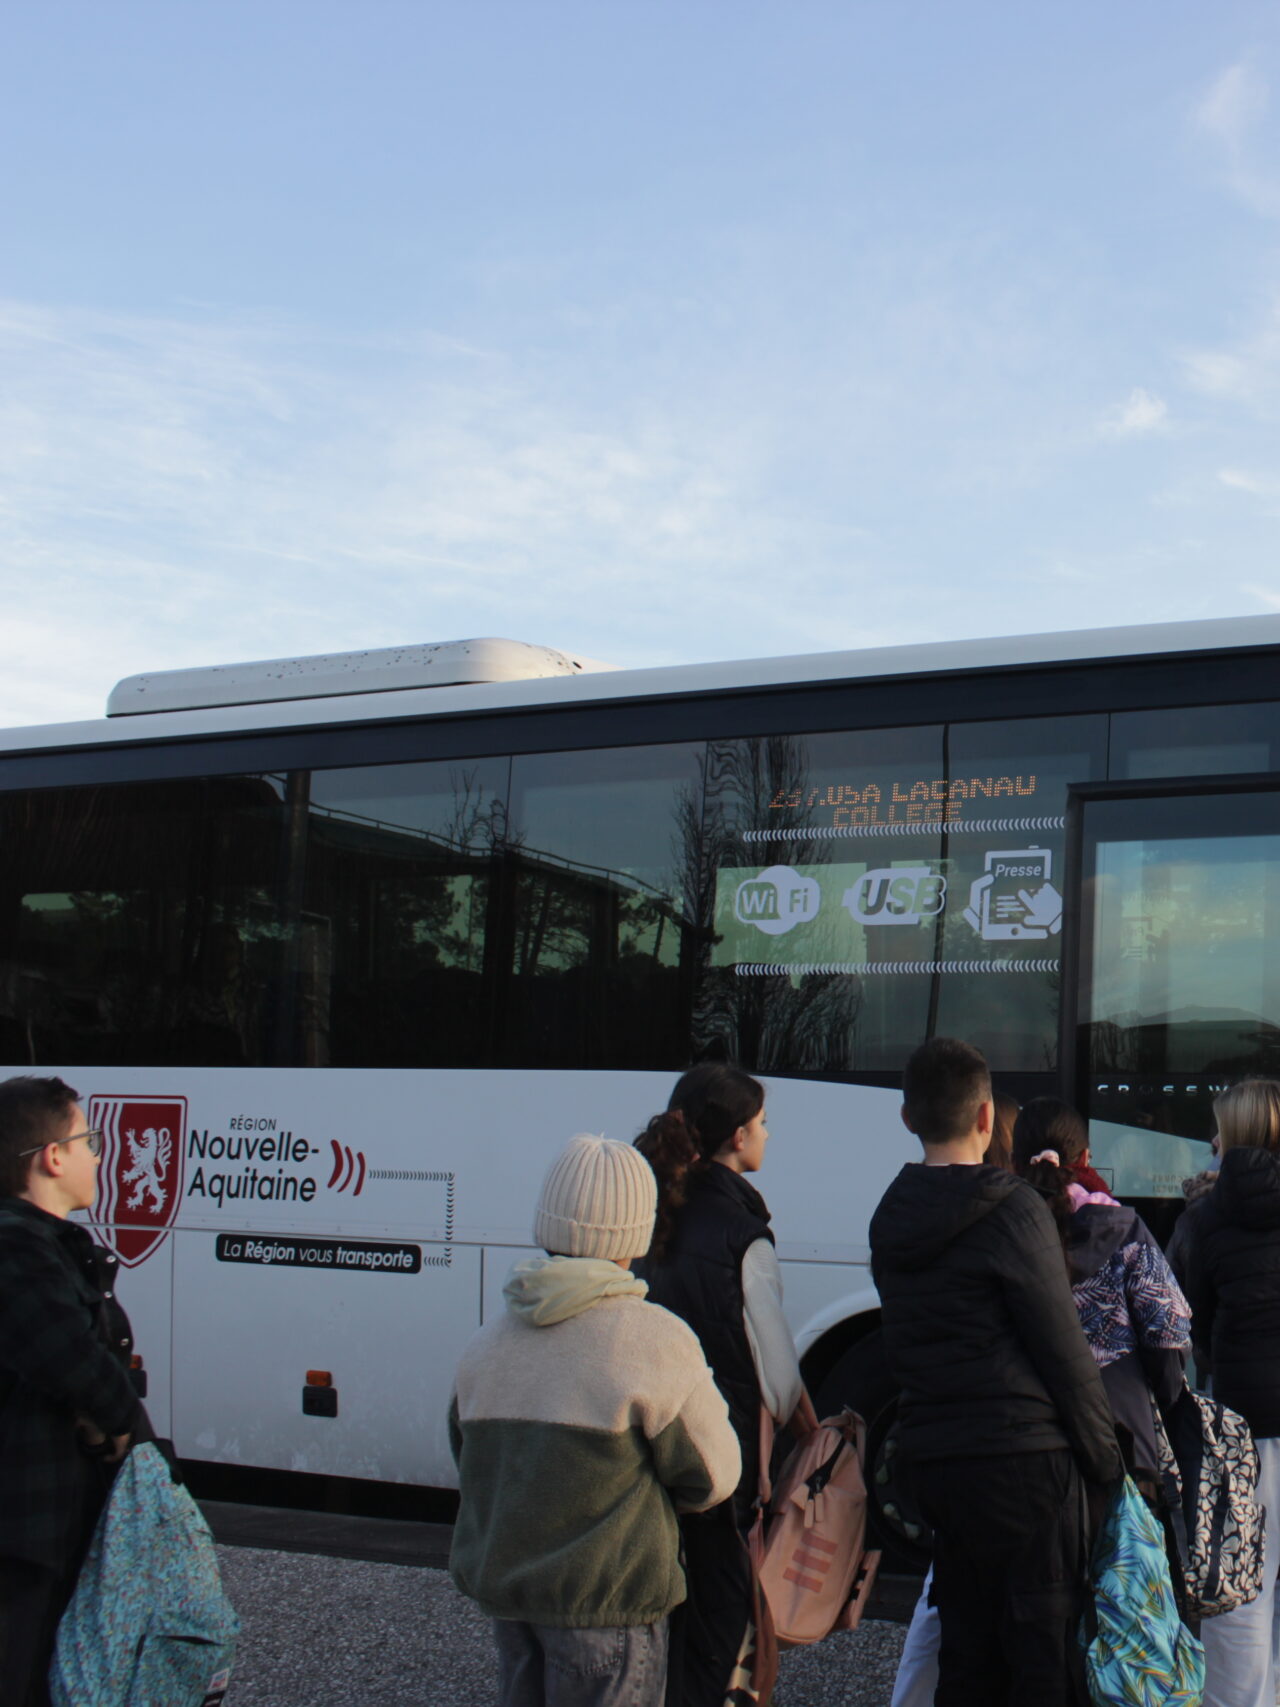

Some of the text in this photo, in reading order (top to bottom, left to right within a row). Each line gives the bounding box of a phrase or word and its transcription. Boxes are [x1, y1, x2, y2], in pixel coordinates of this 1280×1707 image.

[892, 775, 1036, 801] LACANAU
[833, 801, 962, 828] COLLEGE
[995, 863, 1042, 877] Presse
[857, 874, 945, 915] USB
[229, 1114, 277, 1131] RÉGION
[188, 1129, 320, 1163] Nouvelle-
[187, 1166, 317, 1209] Aquitaine
[223, 1240, 414, 1269] La Région vous transporte
